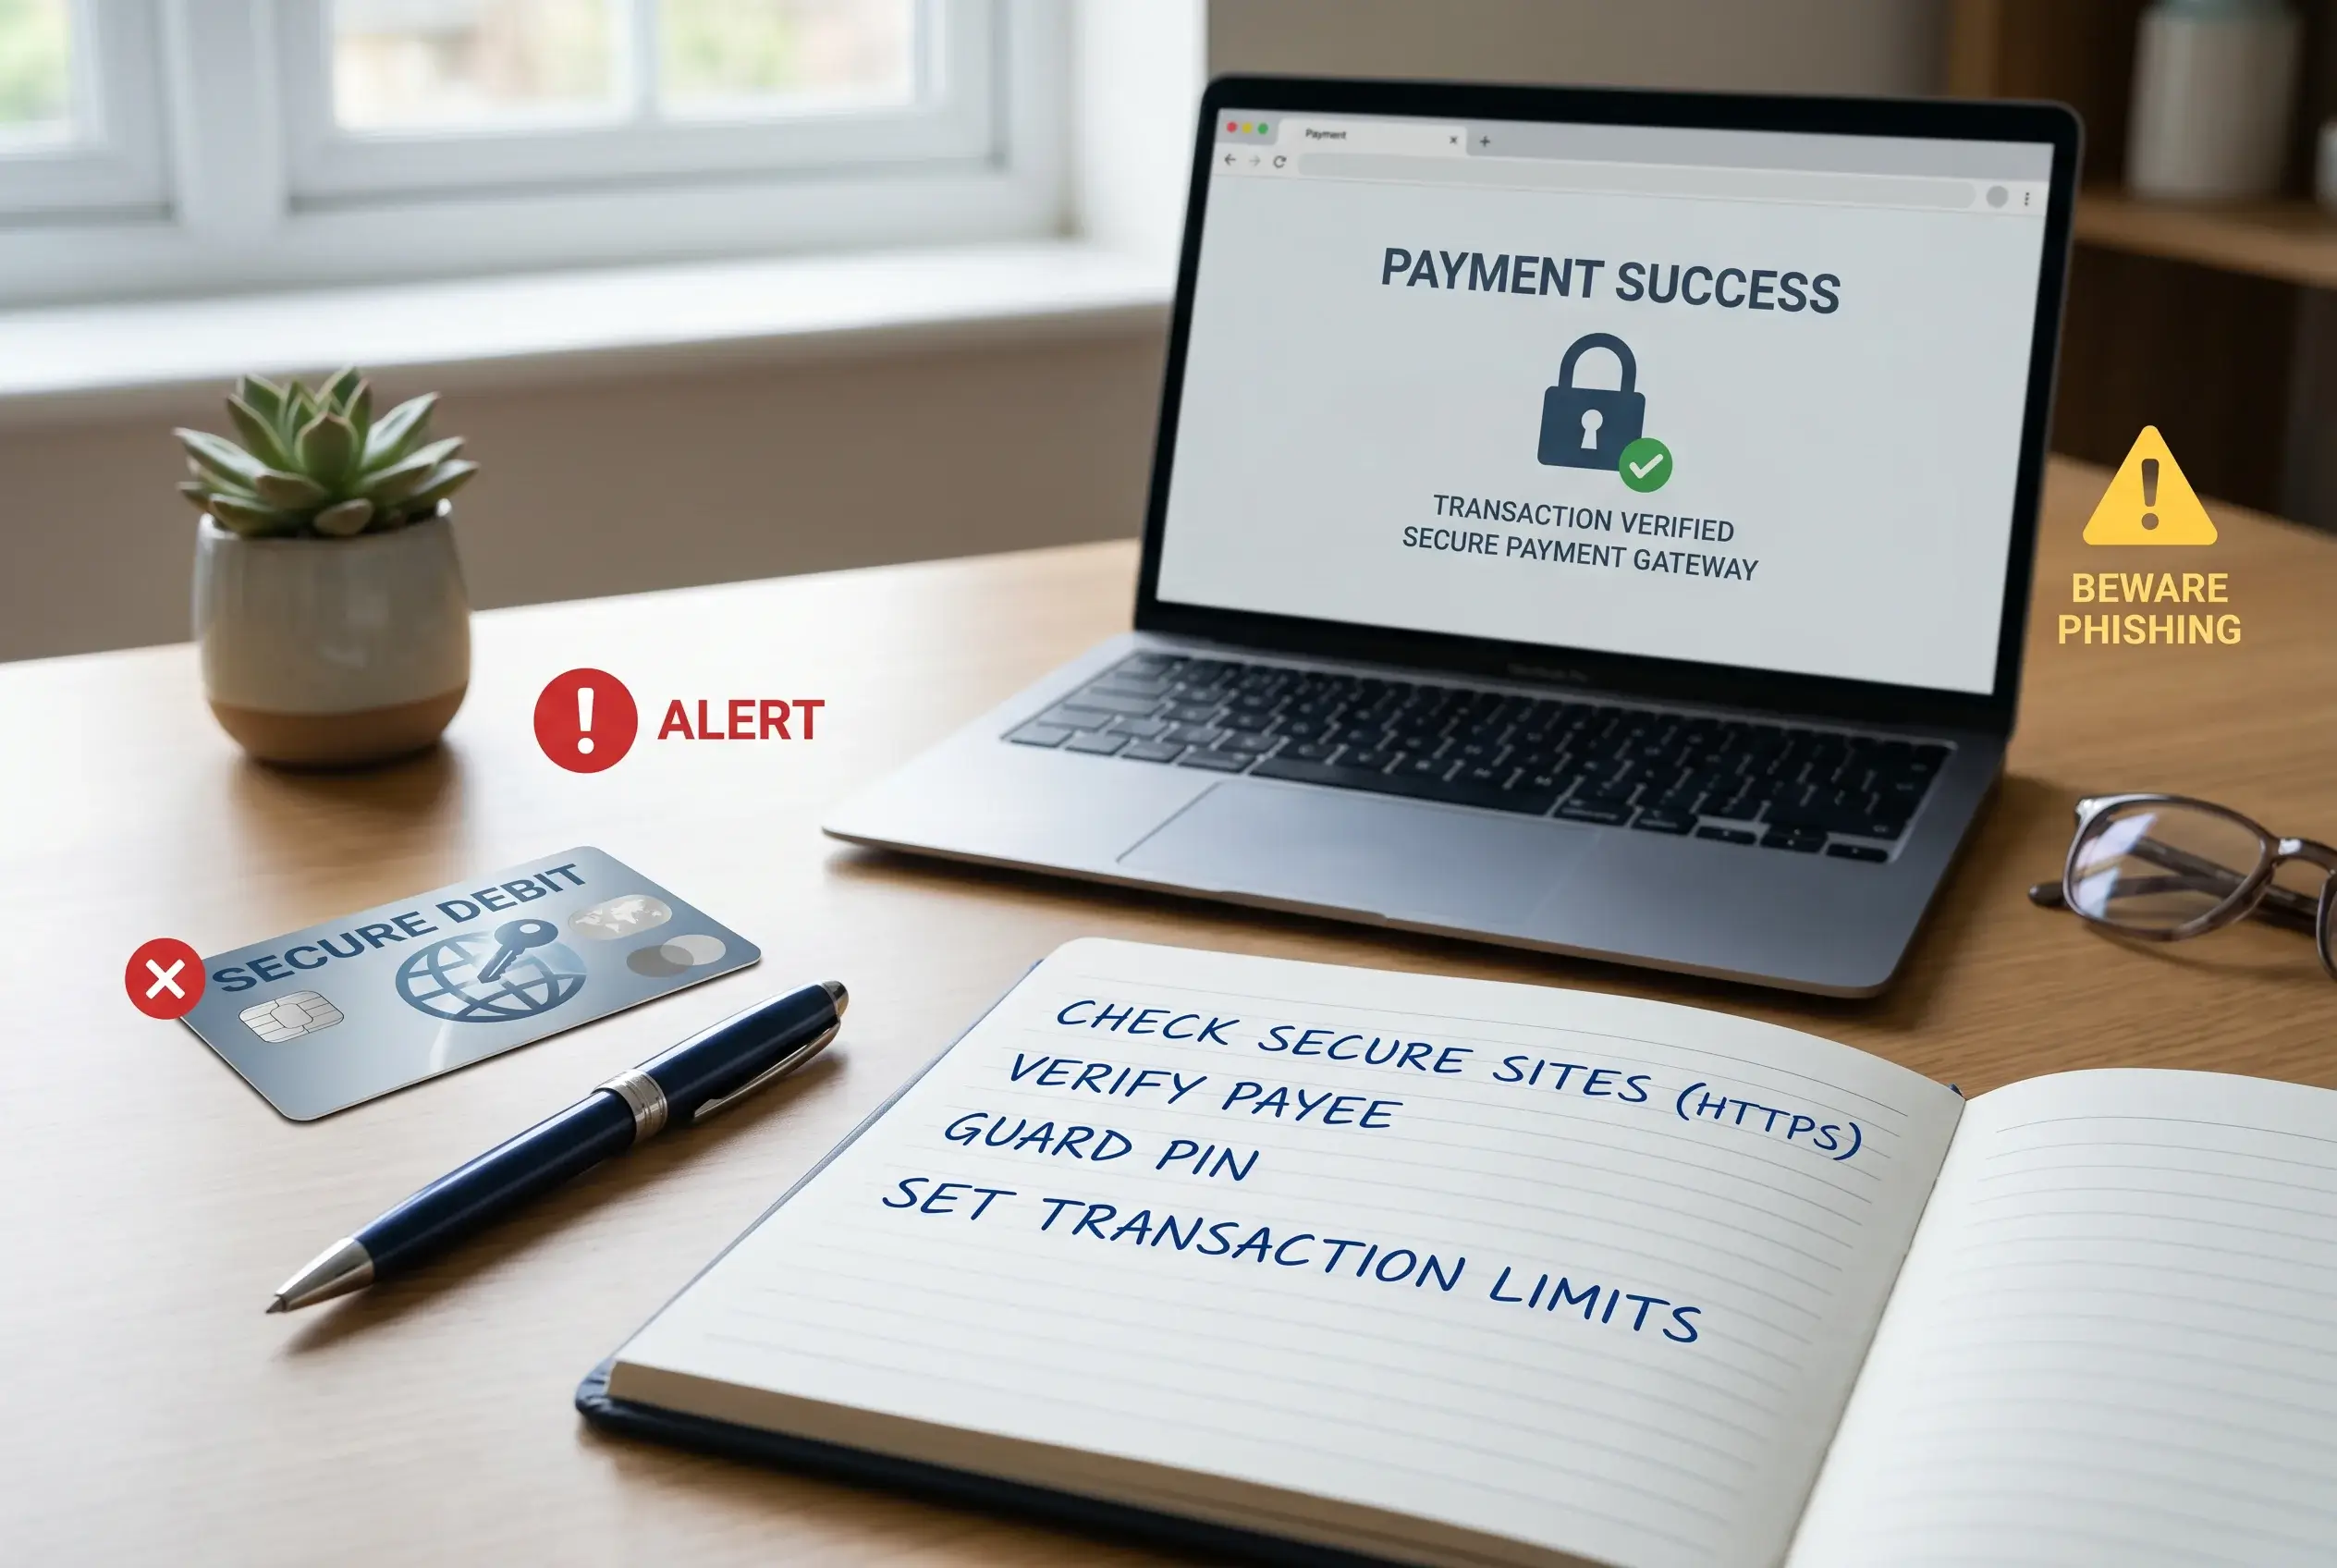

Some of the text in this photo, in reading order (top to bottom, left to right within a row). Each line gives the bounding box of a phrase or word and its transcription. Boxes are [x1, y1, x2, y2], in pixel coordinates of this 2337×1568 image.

[1304, 127, 1348, 141] Payment
[1381, 246, 1842, 315] PAYMENT SUCCESS
[1402, 525, 1760, 582] SECURE PAYMENT GATEWAY
[1433, 494, 1735, 544] TRANSACTION VERIFIED
[211, 862, 587, 994] SECURE DEBIT
[1009, 1052, 1403, 1132] VERIFY PAYEE
[1056, 998, 1863, 1162] CHECK SECURE SITES (HTTPS)
[943, 1111, 1261, 1183] GUARD PIN
[880, 1176, 1702, 1345] SET TRANSACTION LIMITS
